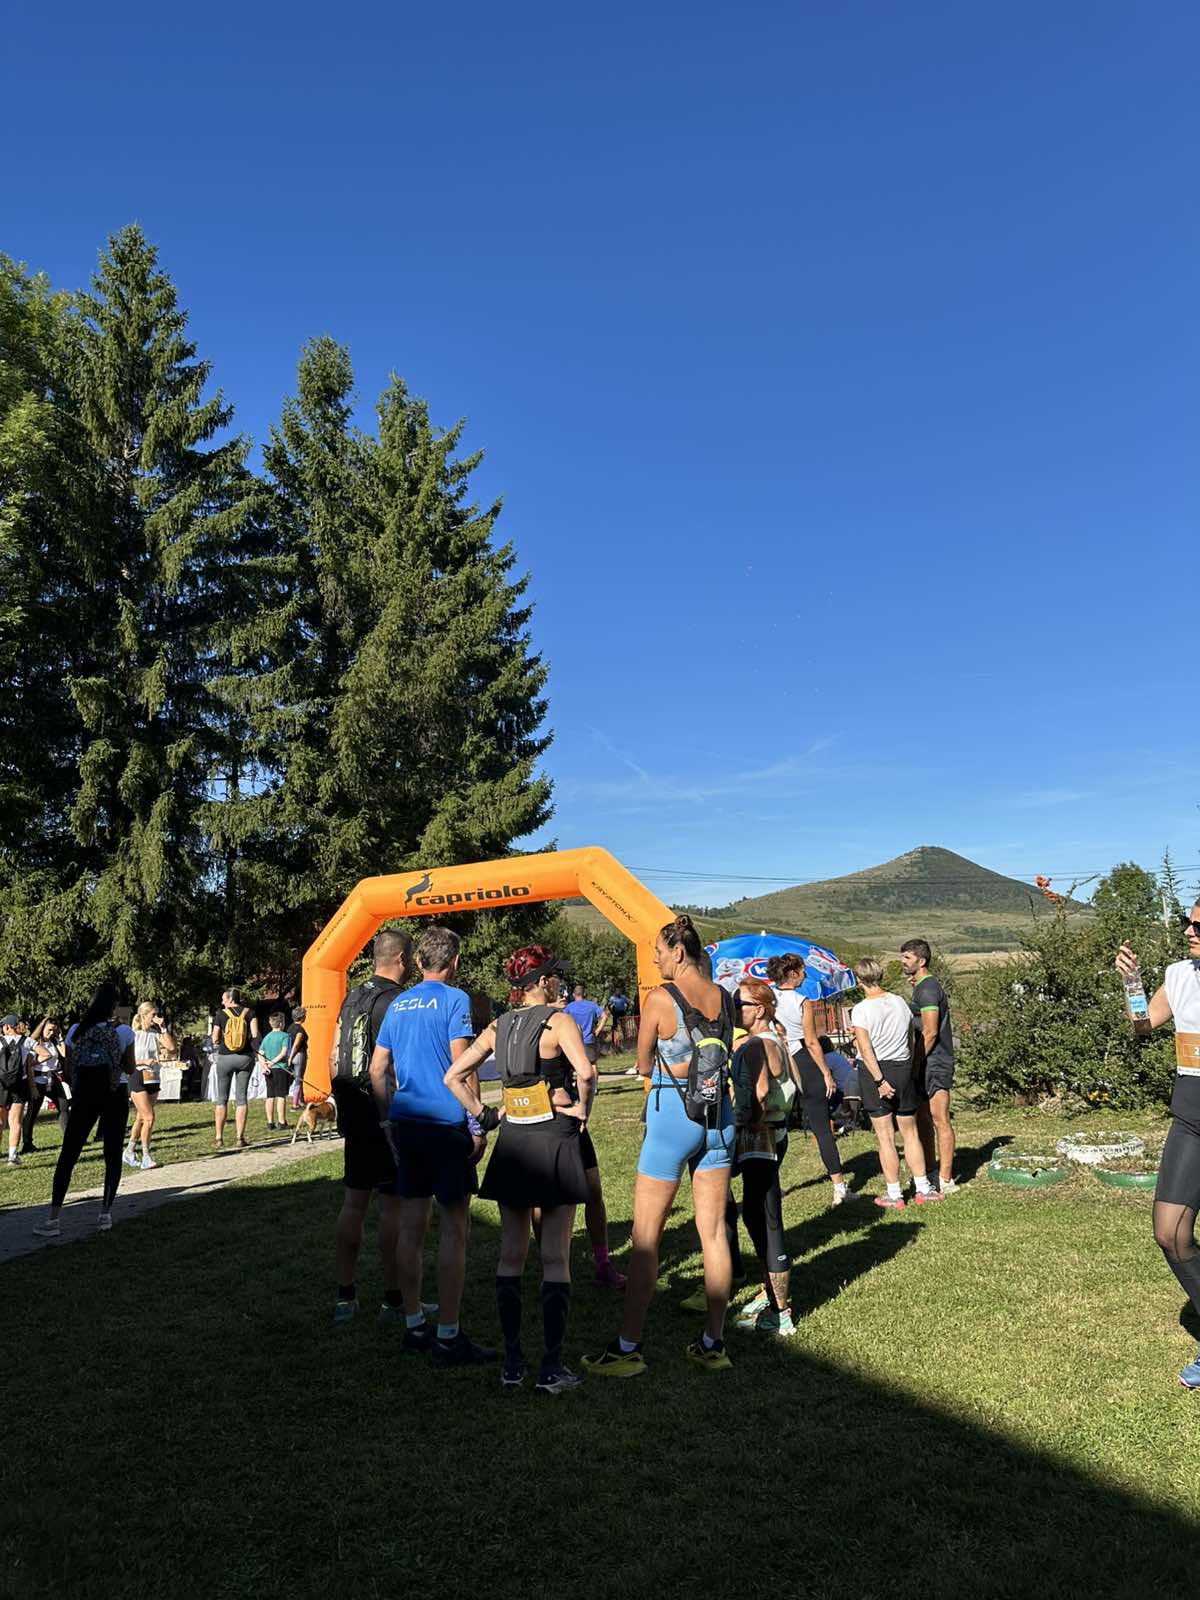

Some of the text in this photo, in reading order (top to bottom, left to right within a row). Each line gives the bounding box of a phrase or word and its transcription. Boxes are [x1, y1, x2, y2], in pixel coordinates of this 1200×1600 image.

[415, 885, 530, 906] capriolo
[393, 997, 438, 1012] TESLA
[512, 1097, 530, 1106] 110
